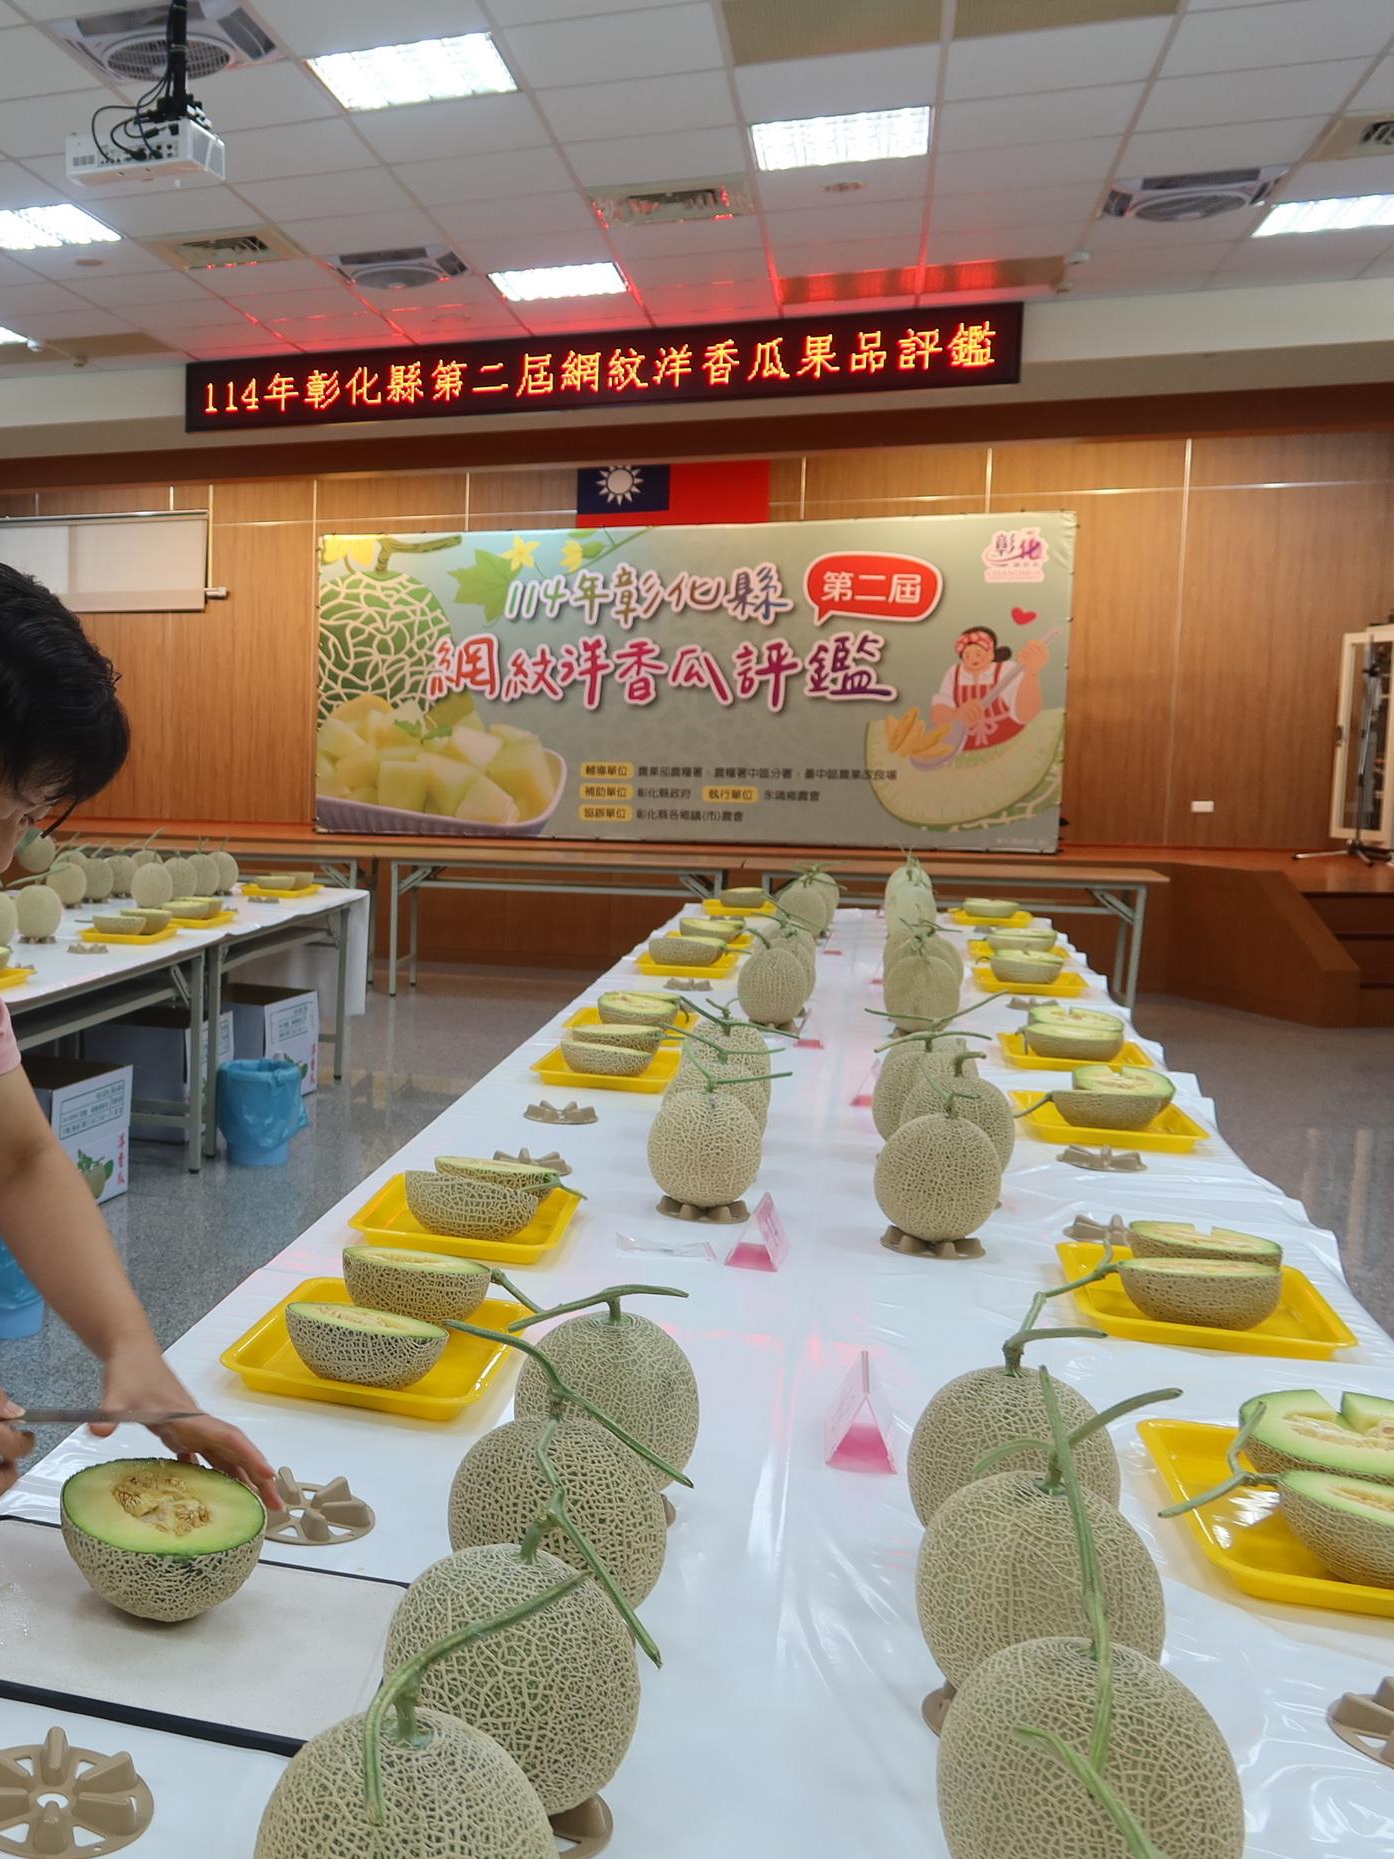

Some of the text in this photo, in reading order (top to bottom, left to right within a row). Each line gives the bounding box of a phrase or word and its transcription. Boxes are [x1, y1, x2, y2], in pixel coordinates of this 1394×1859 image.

[203, 320, 998, 413] 114年彰化縣第二屆網紋洋香瓜果品評鑑
[508, 565, 922, 627] 114年彰化縣 第二屆
[428, 634, 893, 707] 網紋洋香瓜評鑑
[584, 787, 692, 800] 補助單位 彰化縣政府
[708, 788, 754, 800] 執行單位
